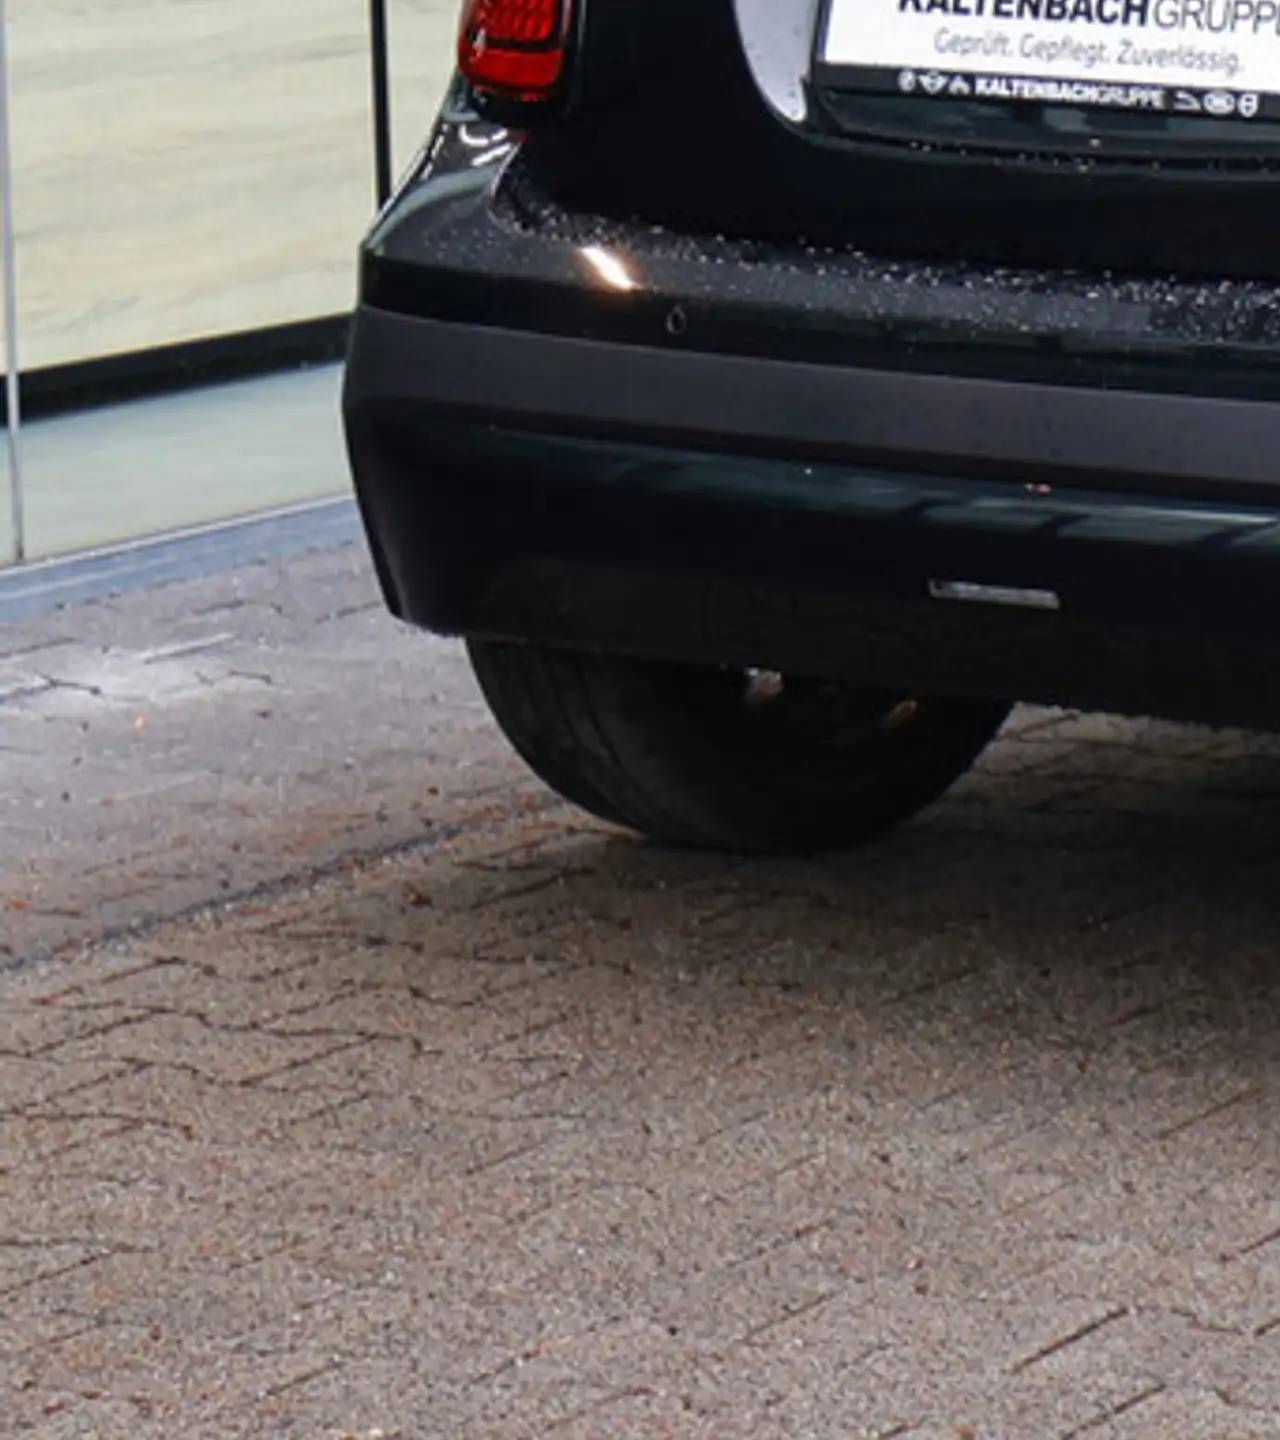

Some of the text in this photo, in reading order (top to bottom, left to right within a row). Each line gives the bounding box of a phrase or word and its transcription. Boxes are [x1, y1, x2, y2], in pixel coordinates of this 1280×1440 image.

[933, 26, 1243, 78] Geprüft. Gepflegt. Zuverlässig.
